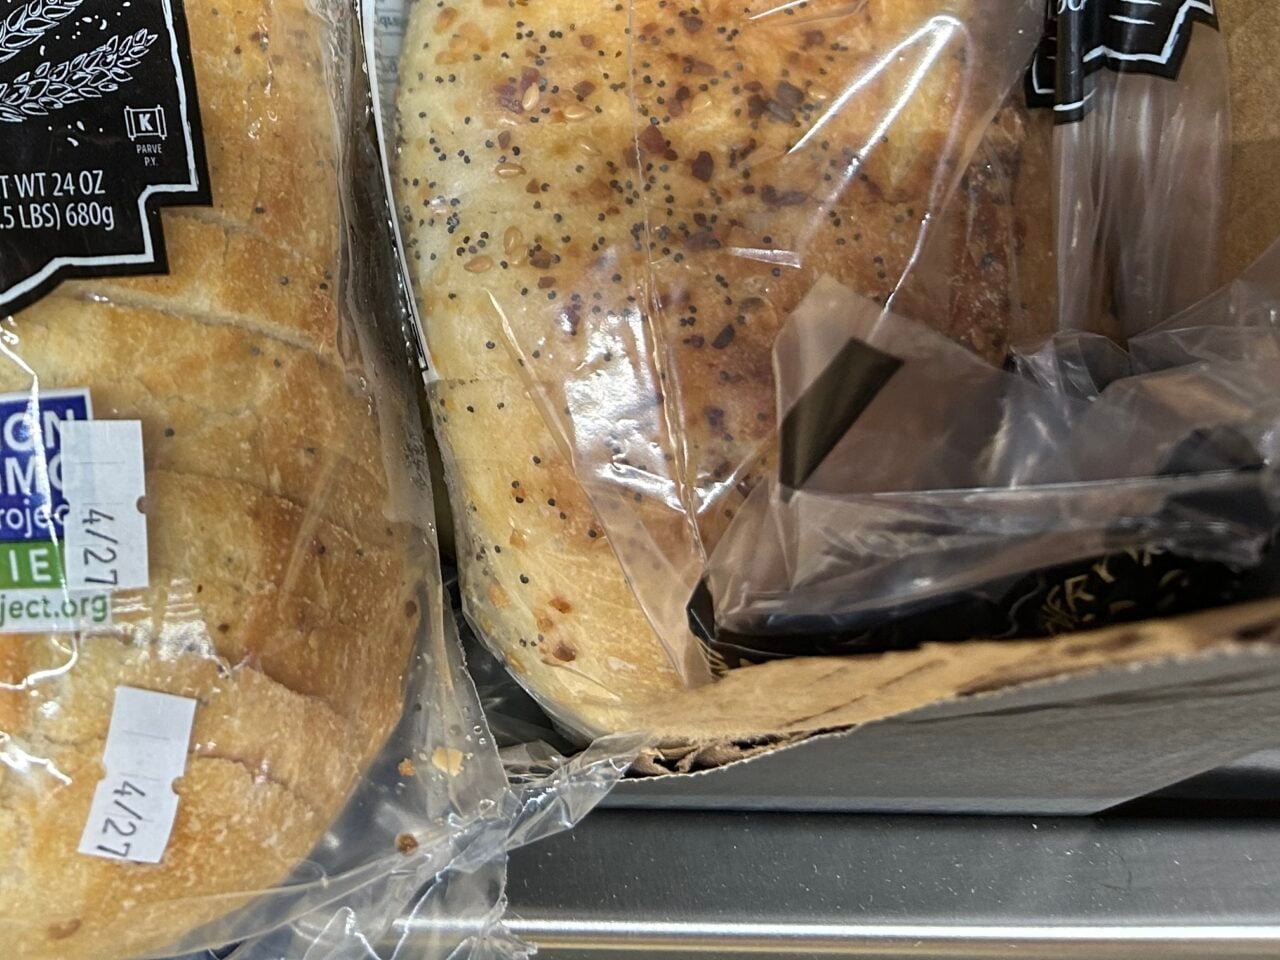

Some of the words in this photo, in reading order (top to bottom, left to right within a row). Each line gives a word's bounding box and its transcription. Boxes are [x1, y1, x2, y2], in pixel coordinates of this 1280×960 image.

[136, 144, 162, 154] PARVE
[14, 172, 46, 197] WT
[51, 172, 75, 196] 24
[79, 169, 106, 195] OZ
[18, 202, 60, 230] LBS)
[66, 201, 114, 230] 680g
[83, 508, 117, 587] 4/27
[96, 779, 146, 859] 4/27
